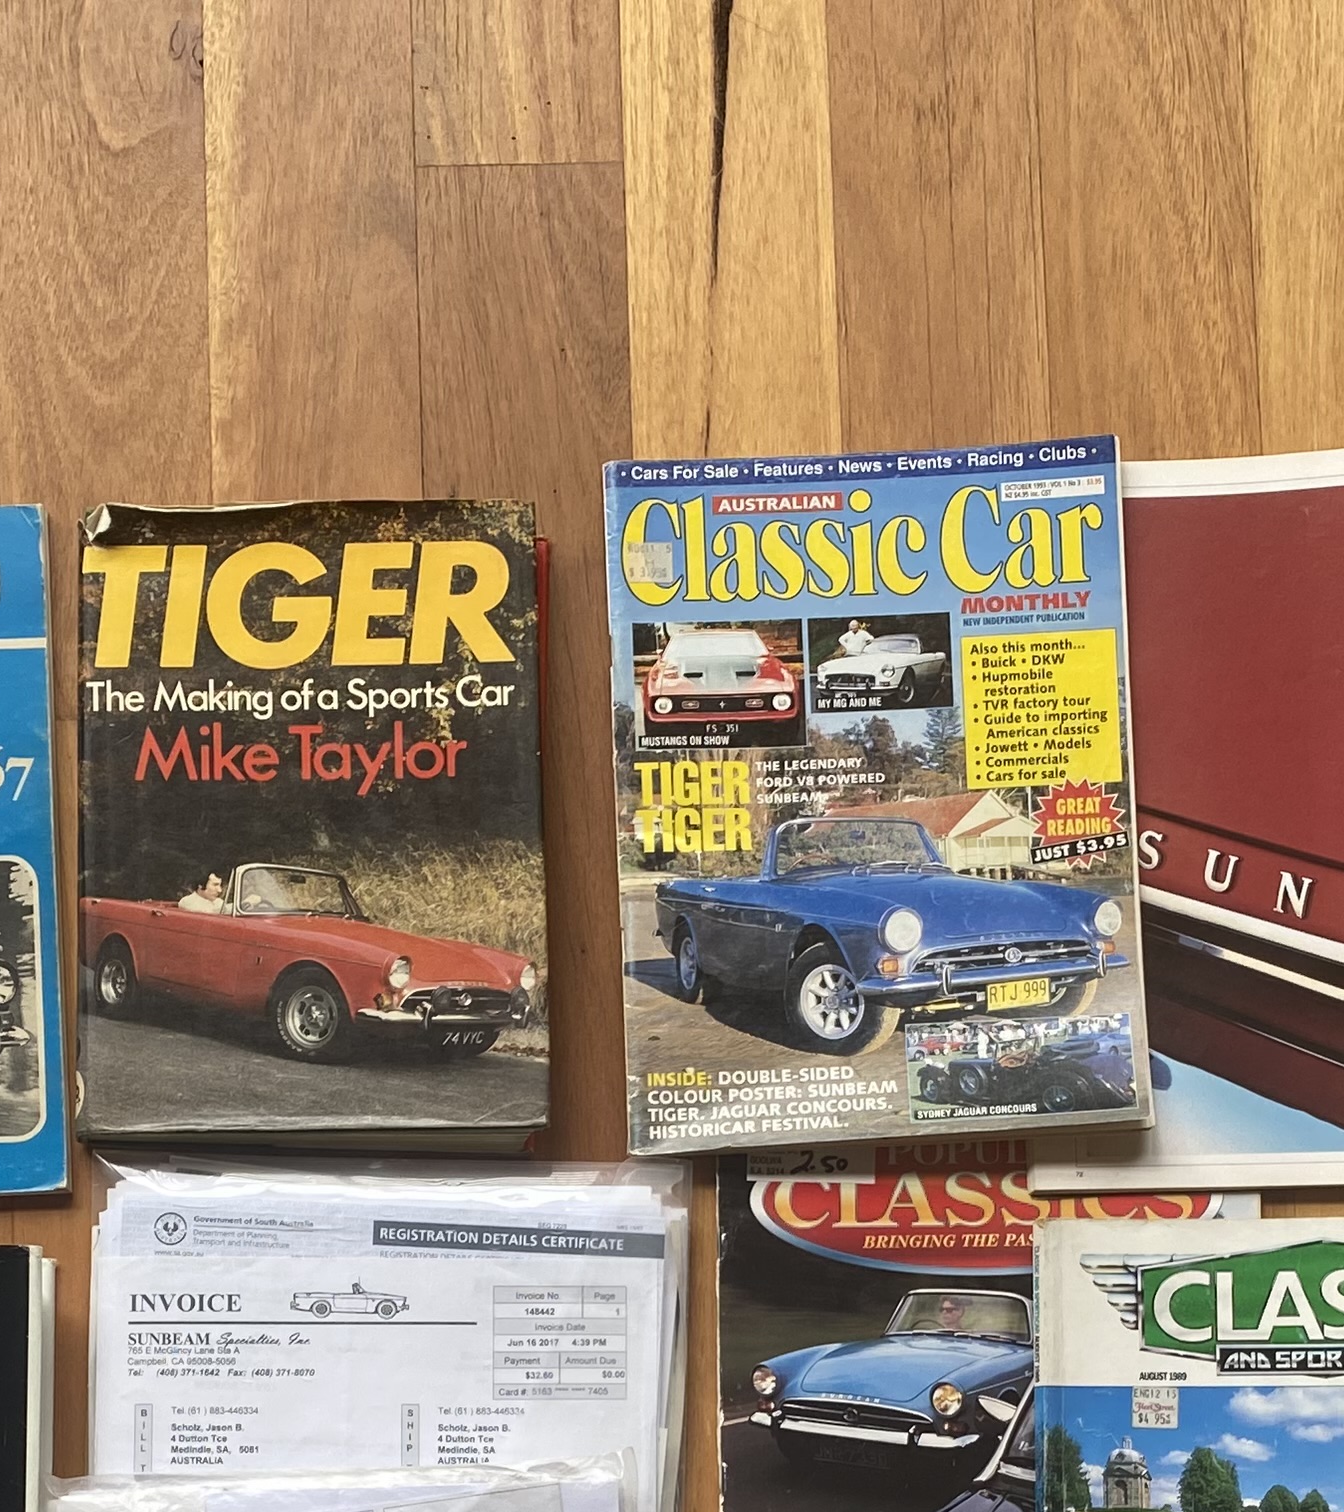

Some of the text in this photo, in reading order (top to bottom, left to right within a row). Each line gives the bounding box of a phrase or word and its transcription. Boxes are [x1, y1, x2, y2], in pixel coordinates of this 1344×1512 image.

[631, 444, 1086, 480] Cars For Sale Features News Events Racing Clubs
[718, 495, 837, 512] AUSTRALIAN
[621, 485, 1104, 606] Classic Car
[82, 541, 515, 669] TIGER
[961, 591, 1091, 614] MONTHLY
[86, 675, 514, 720] The Making of a Sports Car
[134, 720, 467, 796] Mike Taylor
[633, 761, 751, 808] TIGER
[1055, 796, 1101, 817] GREAT
[635, 807, 753, 853] TIGER
[1047, 817, 1111, 836] READING
[1034, 834, 1127, 862] JUST $3.95
[989, 980, 1048, 1005] RTJ 999
[380, 1226, 624, 1251] REGISTRATION DETAILS CERTIFICATE
[129, 1293, 242, 1313] INVOICE
[507, 1338, 606, 1347] Jun 16 2017 4:39 PM
[1139, 1372, 1187, 1381] AUGUST 1989
